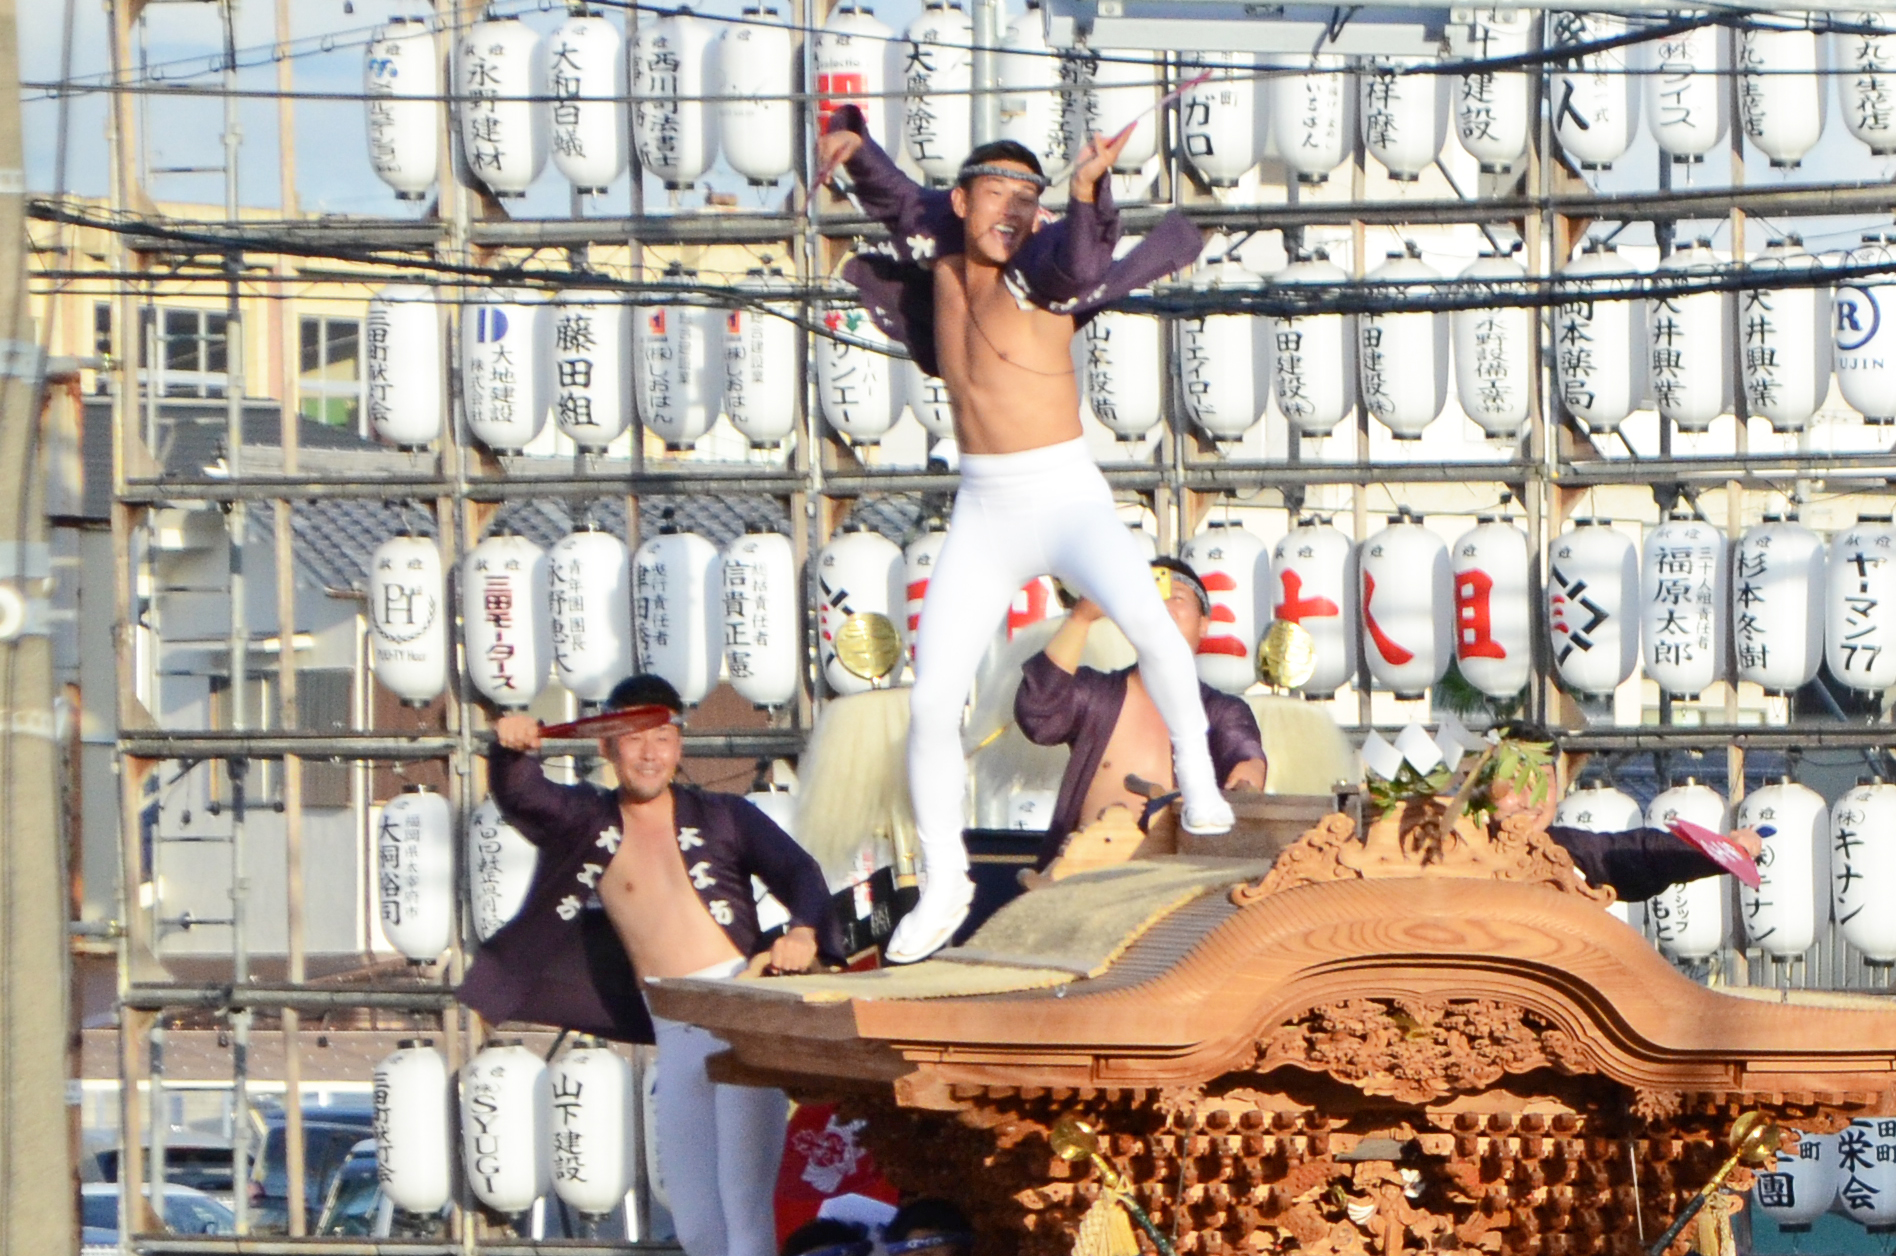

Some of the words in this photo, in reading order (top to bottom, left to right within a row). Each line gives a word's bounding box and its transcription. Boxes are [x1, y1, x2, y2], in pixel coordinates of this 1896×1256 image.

[552, 42, 587, 159] 大和白蟻
[490, 343, 517, 424] 大地建設
[556, 315, 599, 427] 藤田組
[1653, 546, 1694, 667] 福原太郎
[1737, 550, 1770, 670] 杉本冬樹
[551, 1072, 588, 1184] 山下建設
[1837, 1119, 1880, 1210] 栄会
